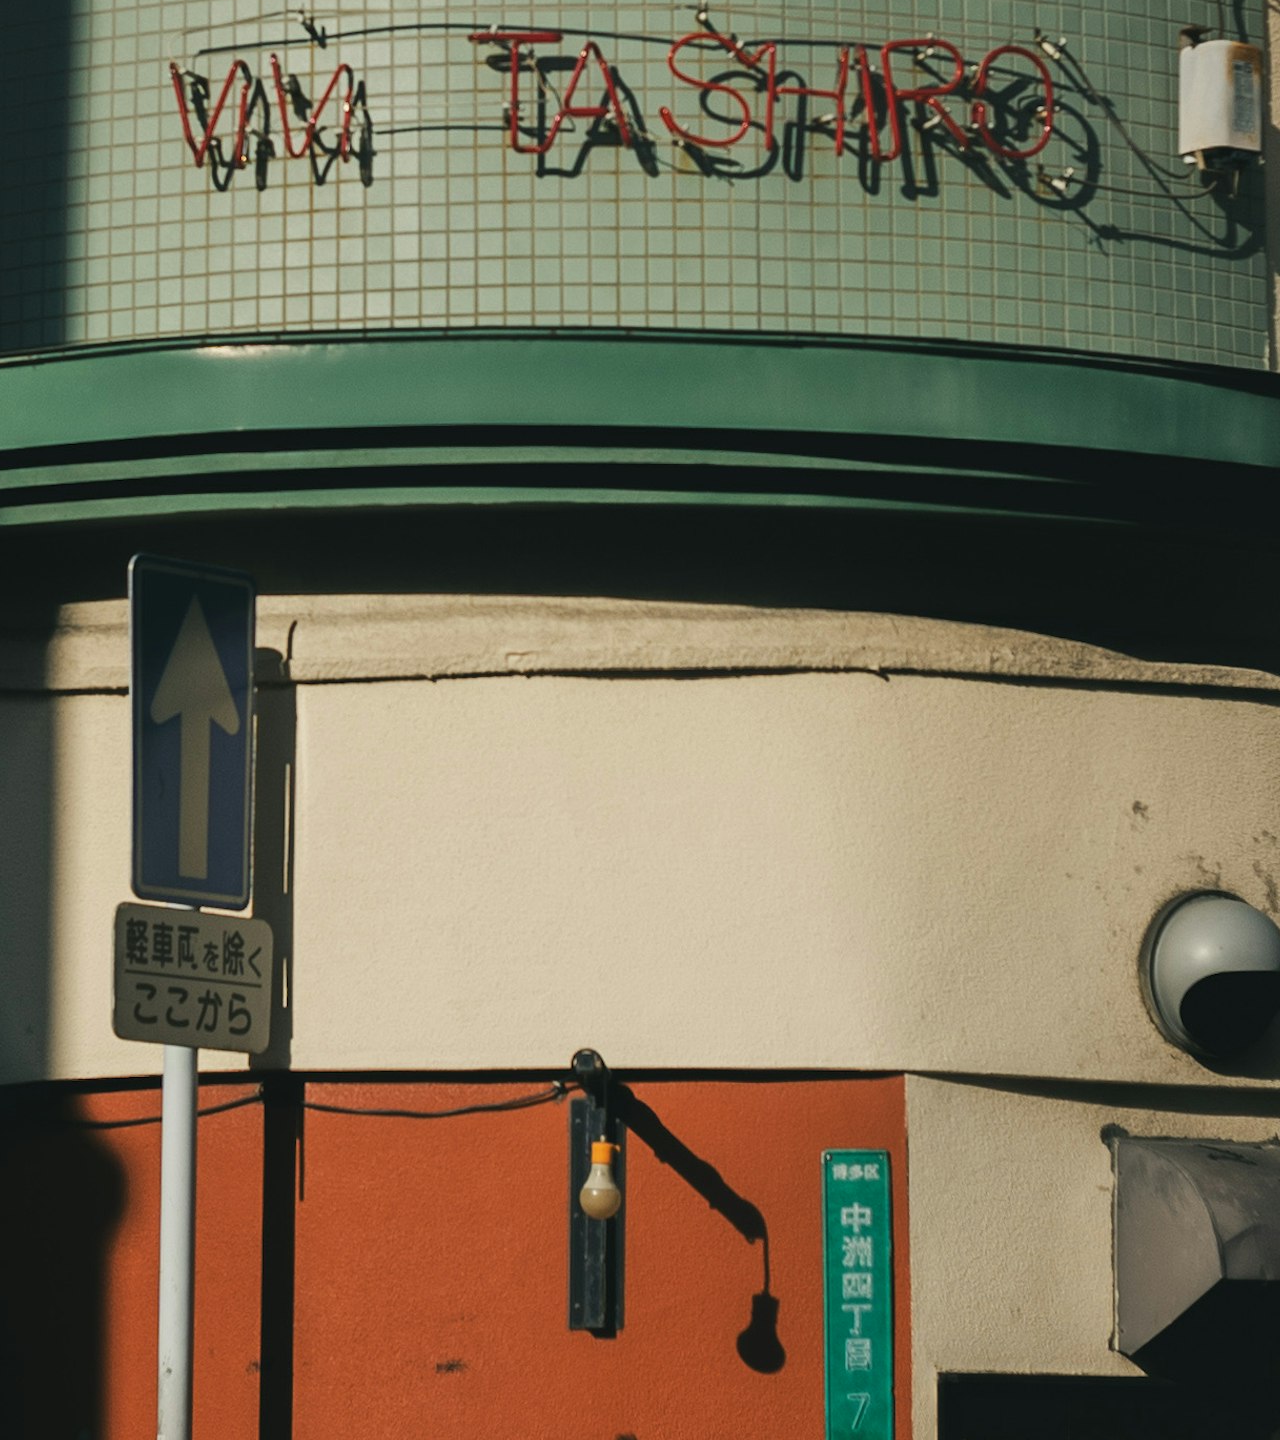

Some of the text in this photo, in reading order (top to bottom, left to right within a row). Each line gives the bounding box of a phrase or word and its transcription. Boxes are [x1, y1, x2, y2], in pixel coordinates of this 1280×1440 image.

[468, 30, 1056, 164] TASHIRO
[133, 983, 254, 1036] ここから
[840, 1201, 874, 1431] 中洲四丁目 7
